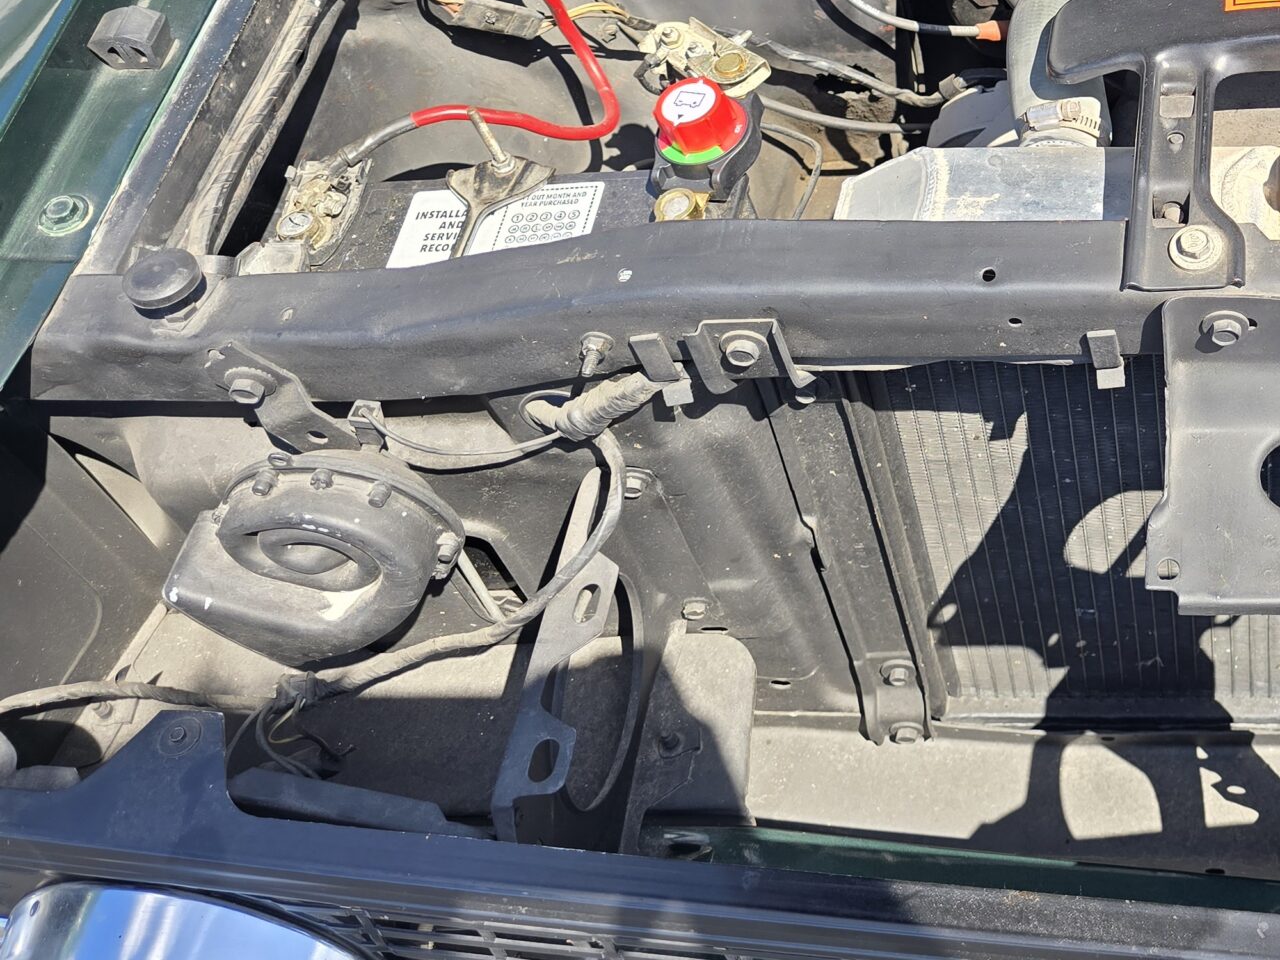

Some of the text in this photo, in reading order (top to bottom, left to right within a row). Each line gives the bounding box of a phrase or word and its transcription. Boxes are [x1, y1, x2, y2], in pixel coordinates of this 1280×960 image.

[546, 192, 571, 200] MONTH
[538, 199, 579, 207] PURCHASED
[415, 209, 468, 220] INSTALLA
[423, 232, 459, 241] SERVI
[420, 243, 450, 253] RECO
